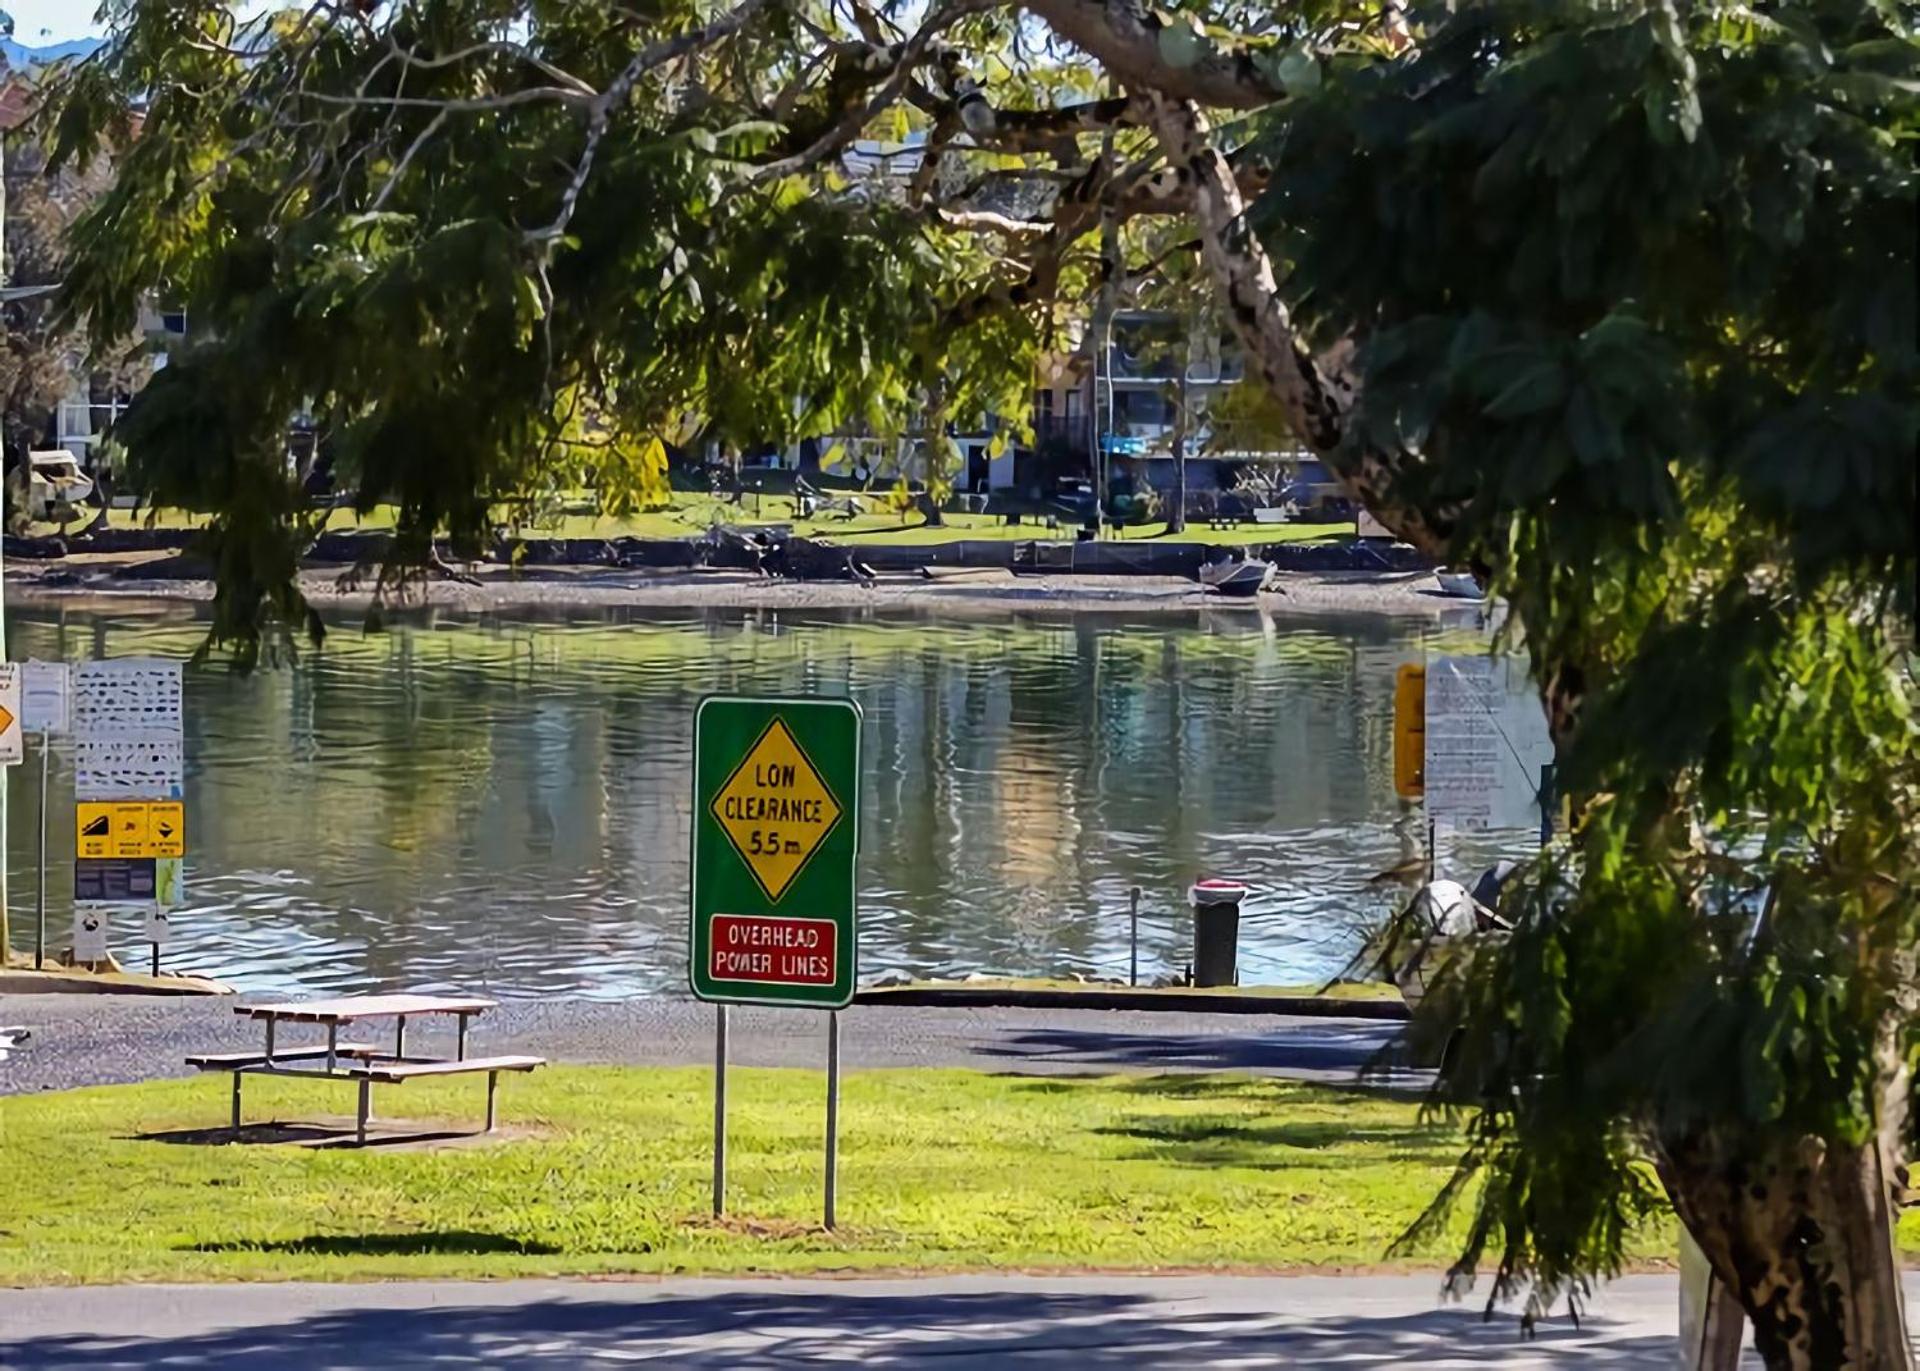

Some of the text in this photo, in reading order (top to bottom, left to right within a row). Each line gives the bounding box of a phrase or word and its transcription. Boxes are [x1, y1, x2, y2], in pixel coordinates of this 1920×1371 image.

[756, 764, 796, 787] LOW
[725, 796, 822, 823] CLEARANCE
[728, 924, 819, 948] OVERHEAD
[716, 951, 829, 977] POWER LINES
